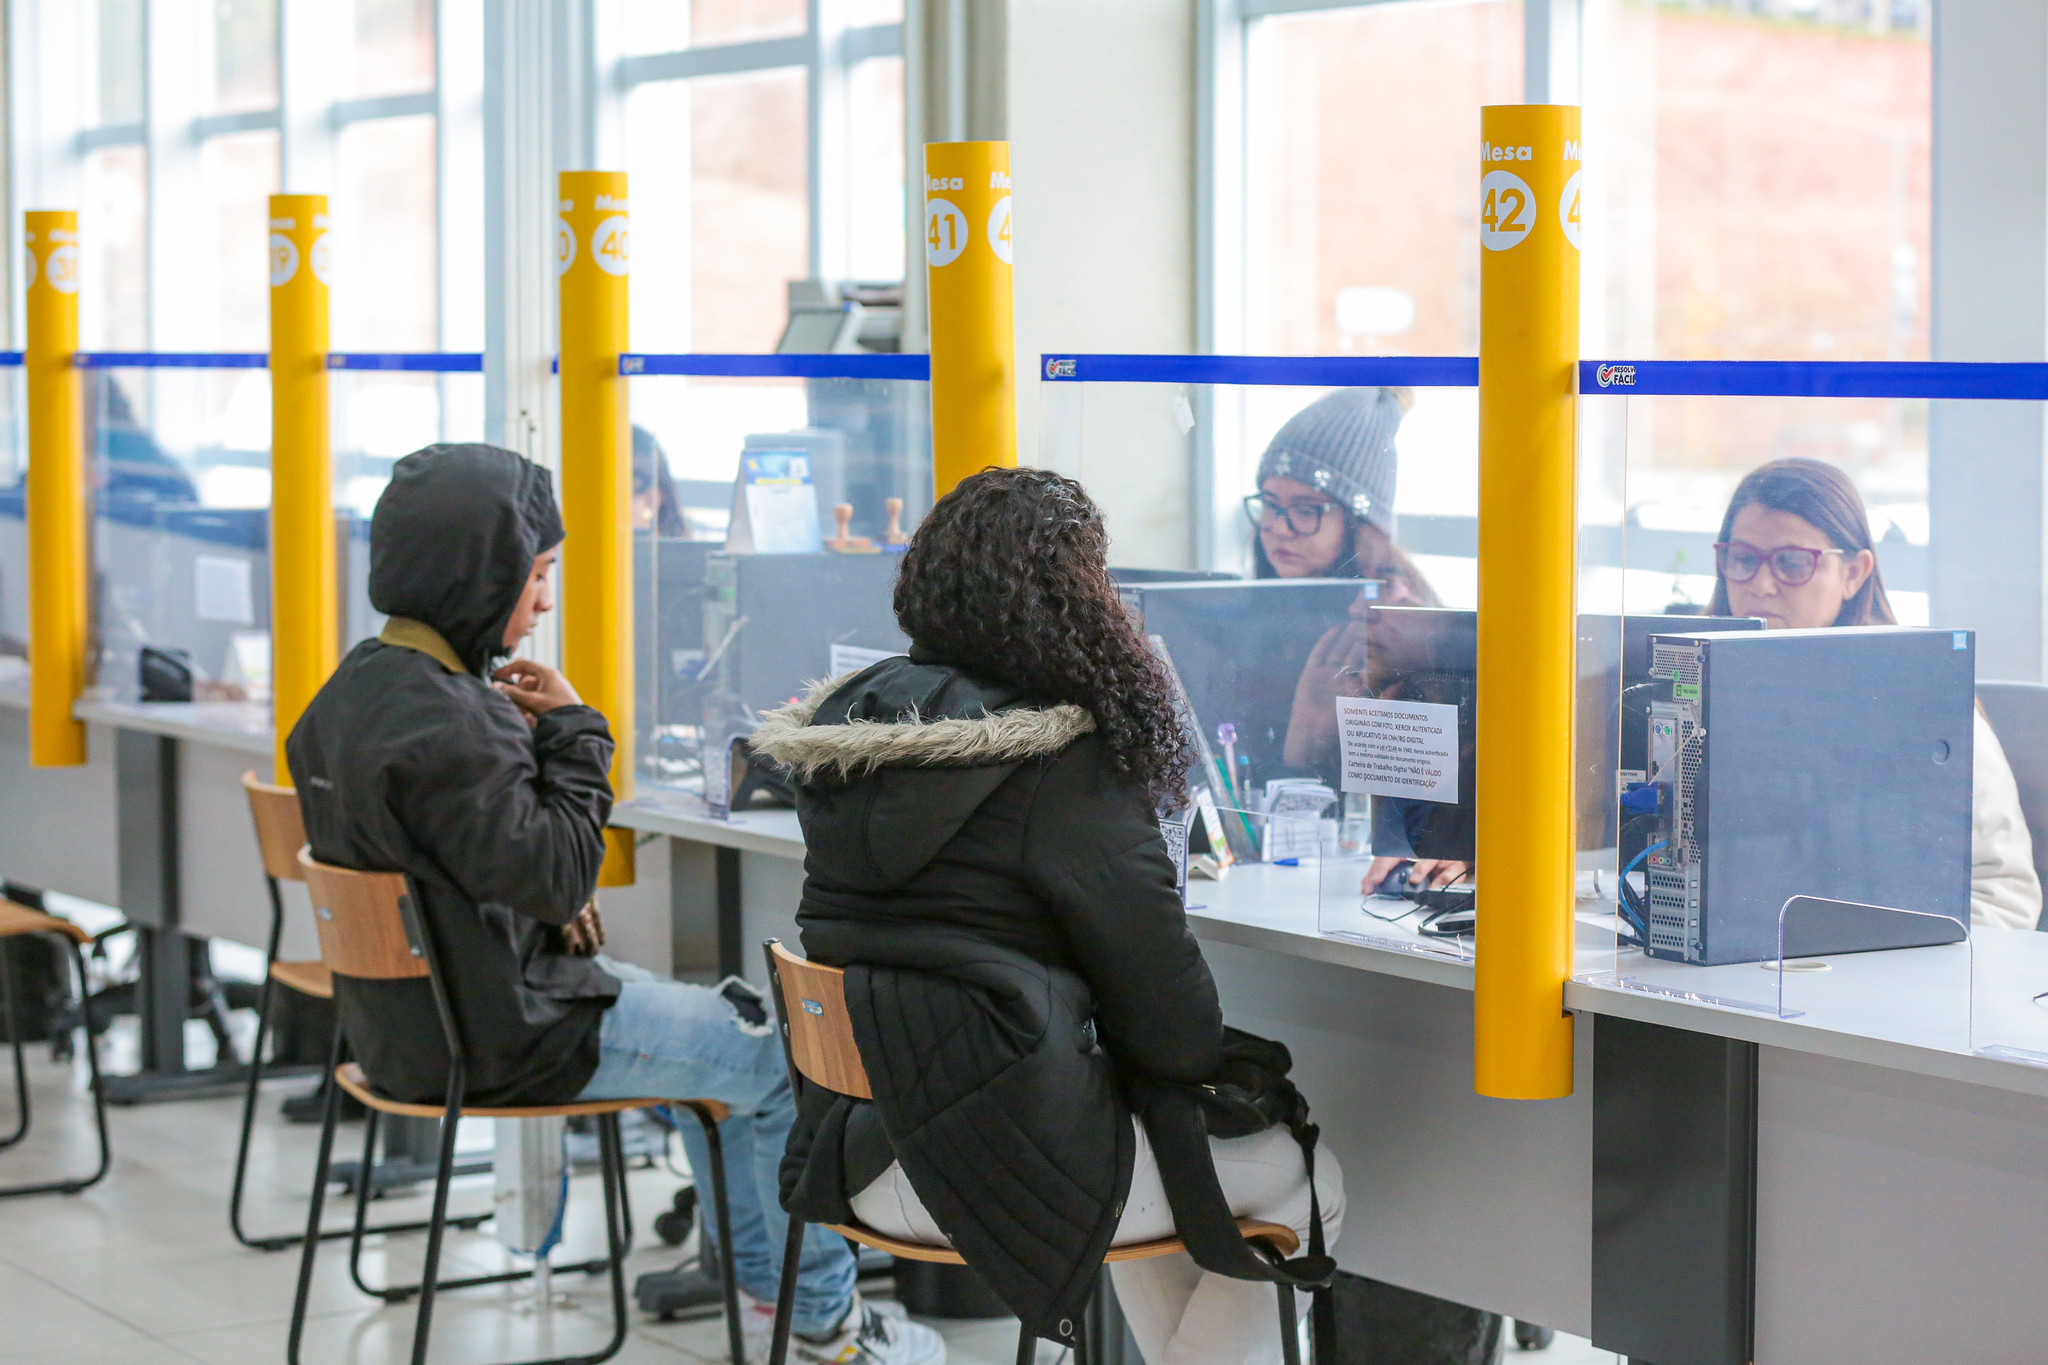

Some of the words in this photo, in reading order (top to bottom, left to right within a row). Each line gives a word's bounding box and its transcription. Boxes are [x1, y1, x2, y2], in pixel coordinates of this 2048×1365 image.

[1481, 141, 1532, 161] Mesa
[1481, 188, 1526, 232] 42
[928, 213, 956, 250] 41
[1344, 708, 1368, 716] SOMENTE
[1369, 710, 1393, 718] ACEITAMOS
[1394, 712, 1428, 721] DOCUMENTOS
[1345, 719, 1370, 727] ORIGINAIS
[1412, 725, 1443, 734] AUTENTICADA
[1356, 731, 1381, 739] APLICATIVO
[1407, 736, 1424, 744] DIGITAL
[1348, 760, 1366, 768] Carteira
[1373, 763, 1392, 771] Trabalho
[1393, 765, 1407, 774] Digital
[1348, 771, 1363, 779] COMO
[1364, 773, 1394, 783] DOCUMENTO
